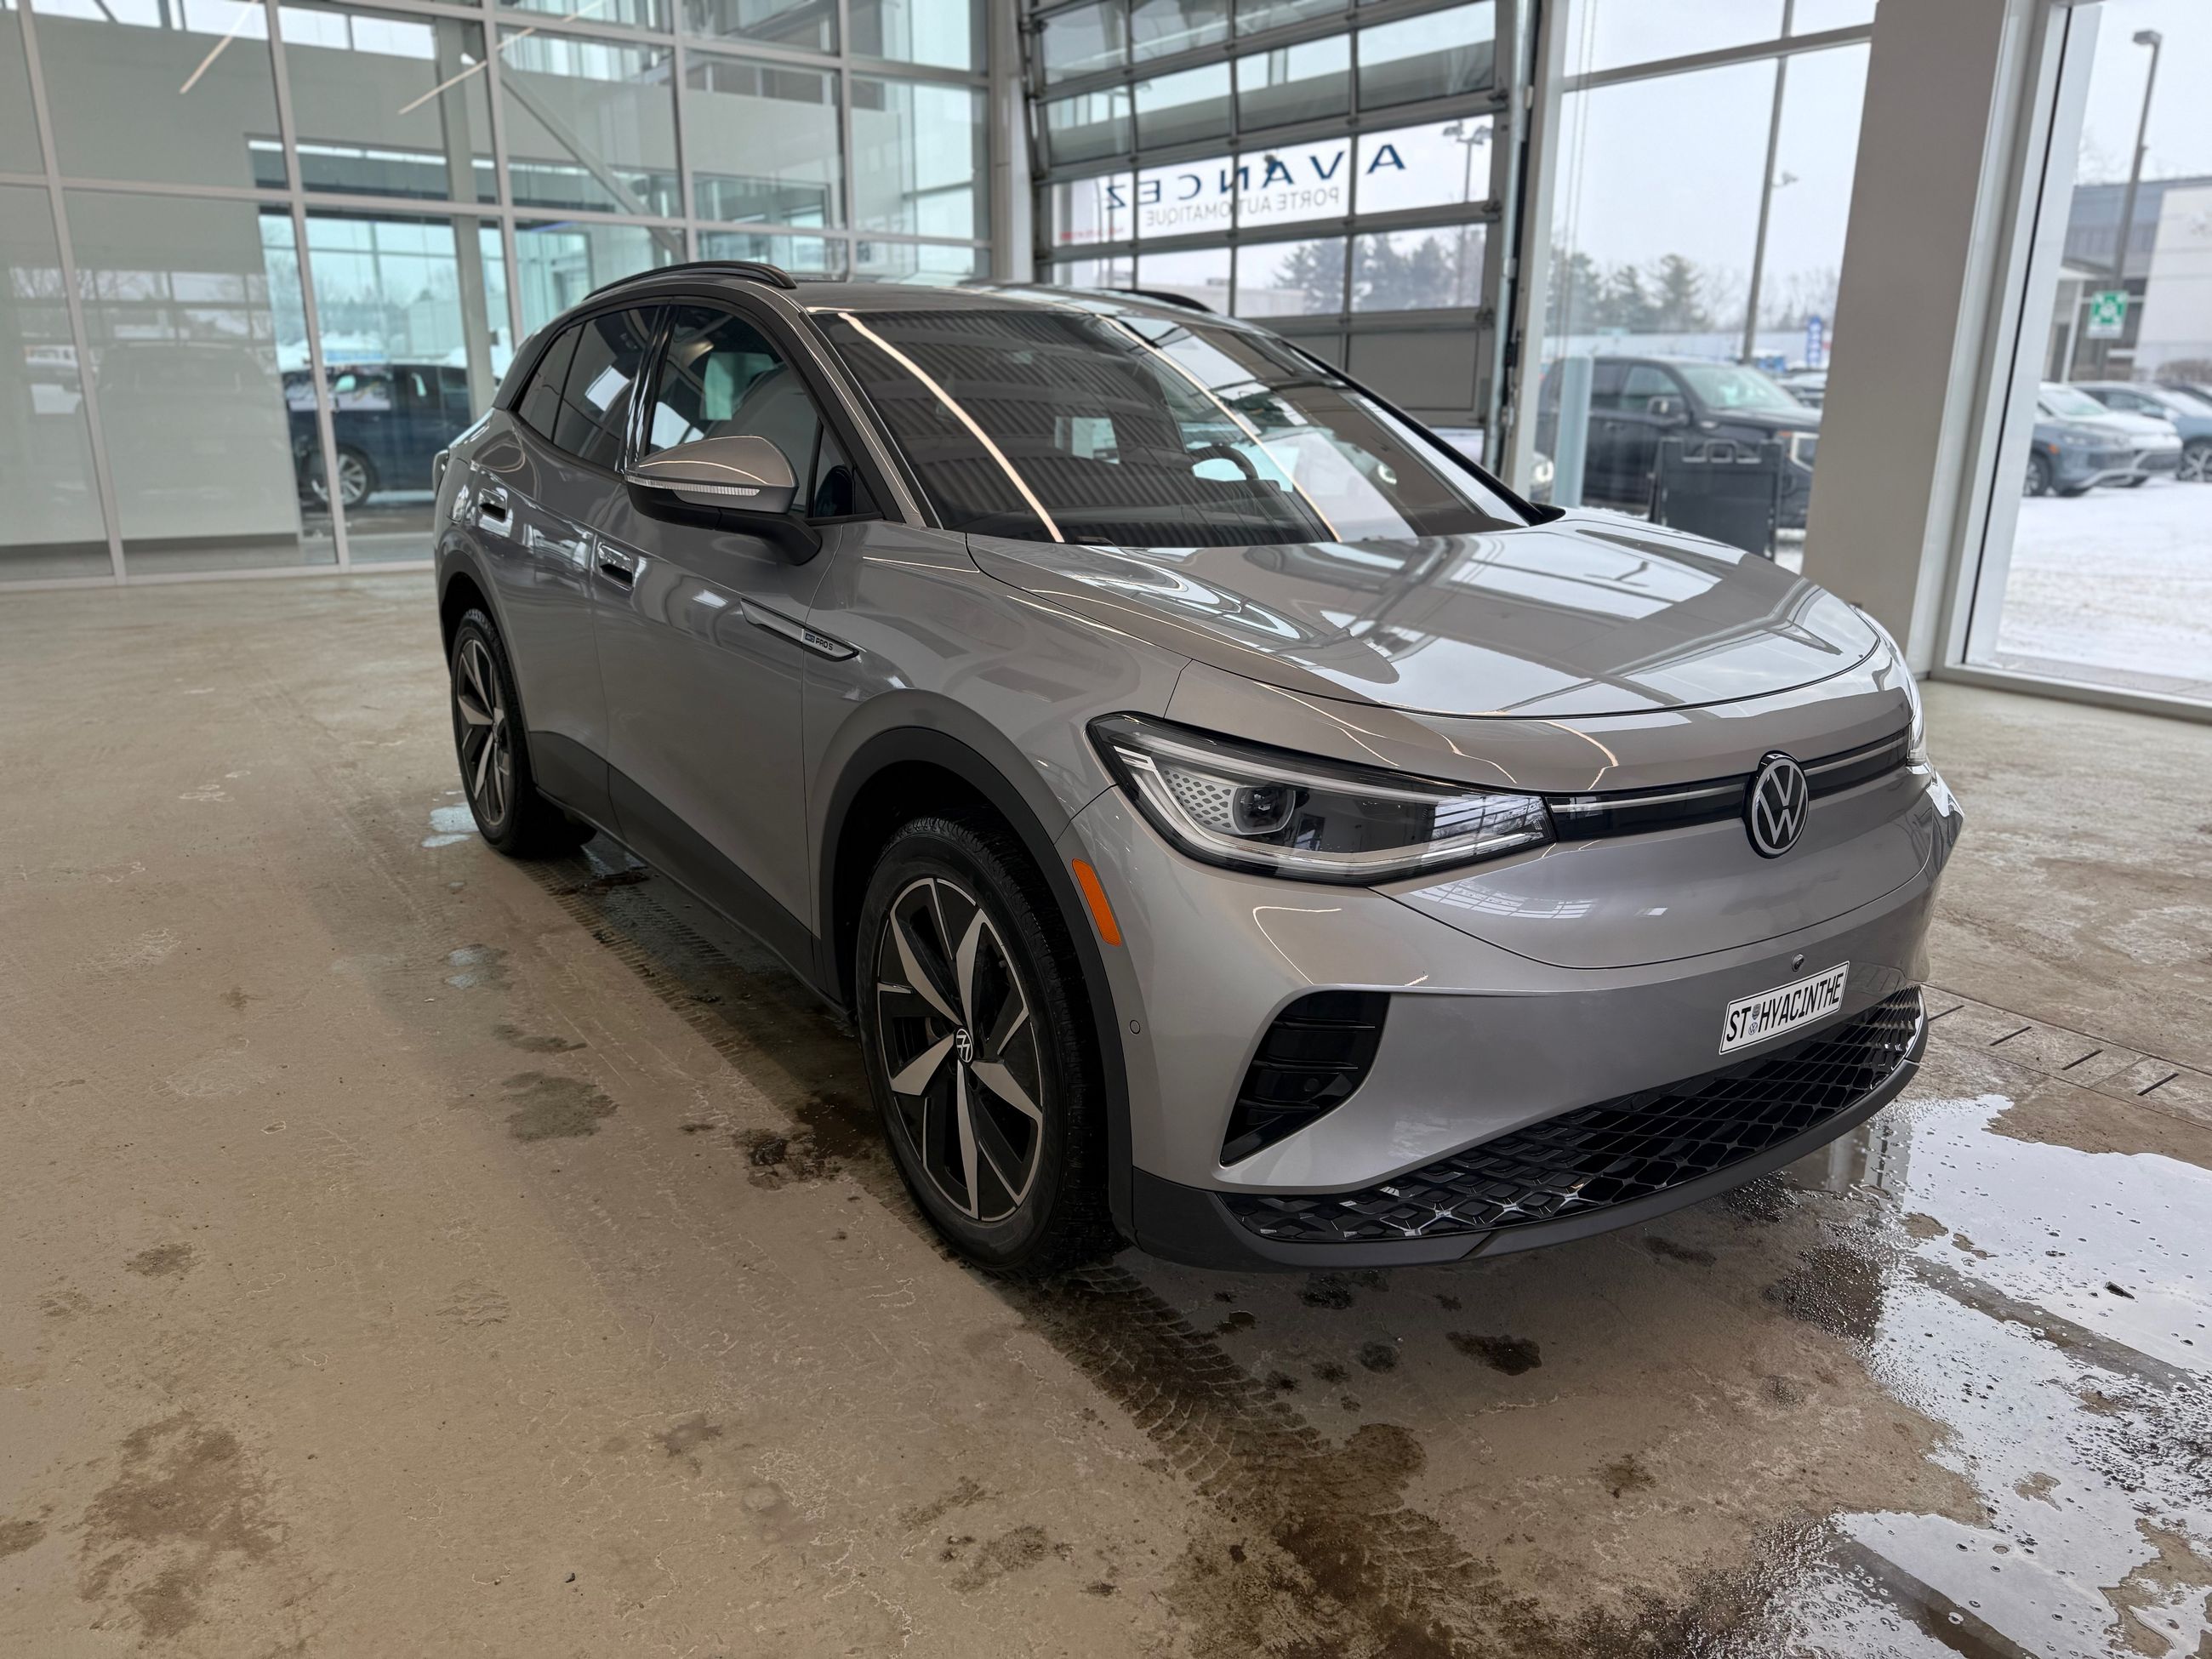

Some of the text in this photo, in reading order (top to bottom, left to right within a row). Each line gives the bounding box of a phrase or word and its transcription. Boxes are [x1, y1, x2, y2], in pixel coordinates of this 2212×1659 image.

[816, 637, 829, 648] PRO
[1726, 972, 1844, 1042] ST HYACINTHE
